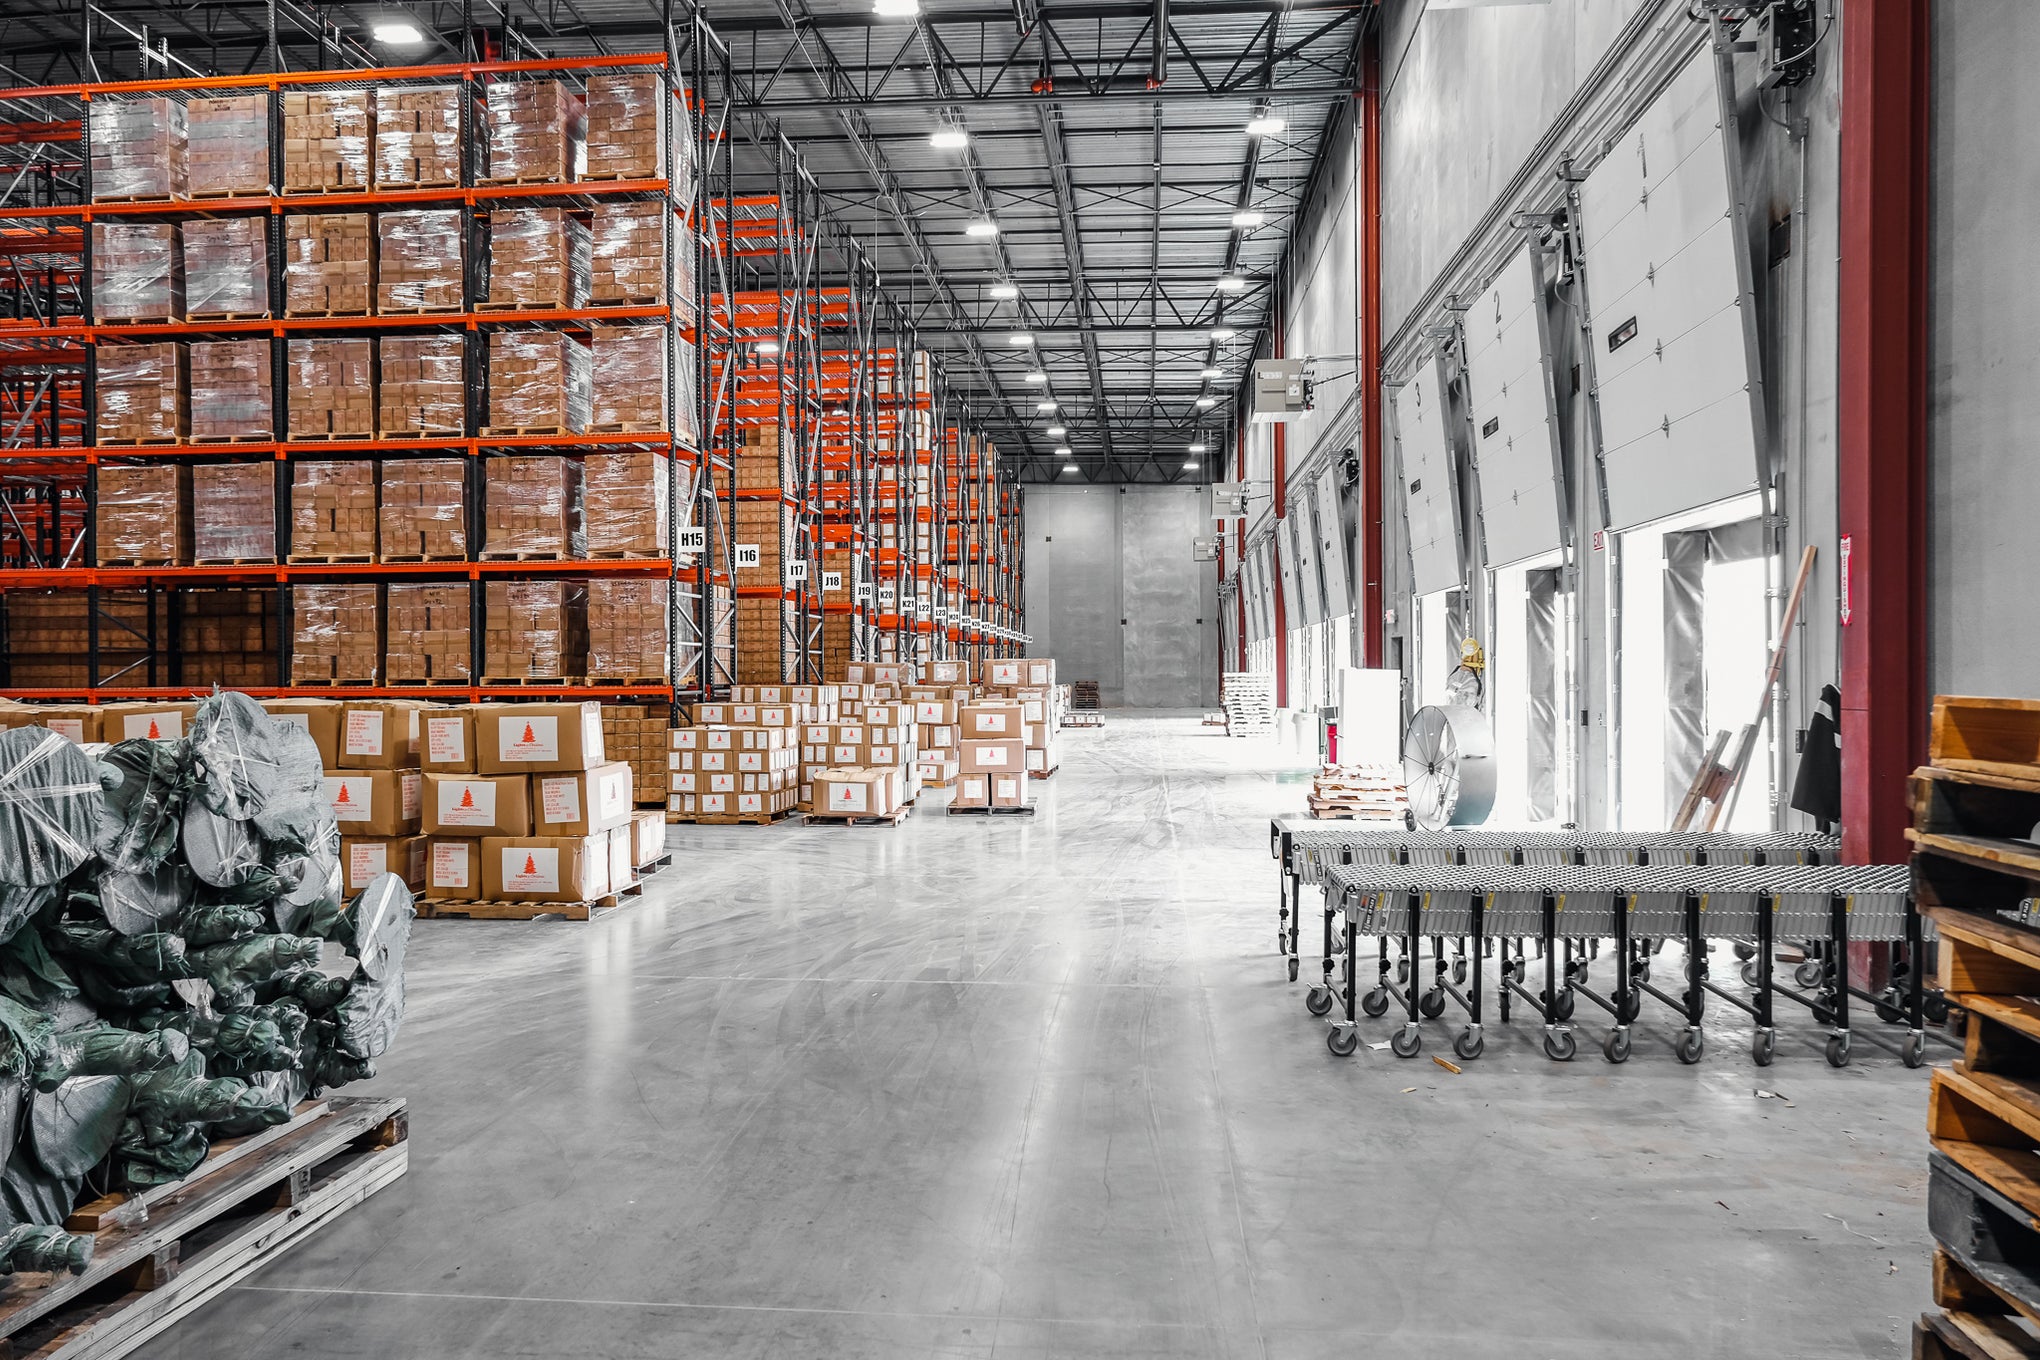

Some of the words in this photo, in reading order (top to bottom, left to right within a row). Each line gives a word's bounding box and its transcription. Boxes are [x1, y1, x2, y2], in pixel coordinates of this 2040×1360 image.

[1494, 290, 1502, 324] 2
[1415, 382, 1421, 407] 3
[681, 533, 703, 546] H15
[740, 550, 756, 561] I16
[791, 565, 804, 575] I17
[825, 577, 839, 586] J18
[858, 587, 871, 595] J19
[880, 591, 893, 599] K20
